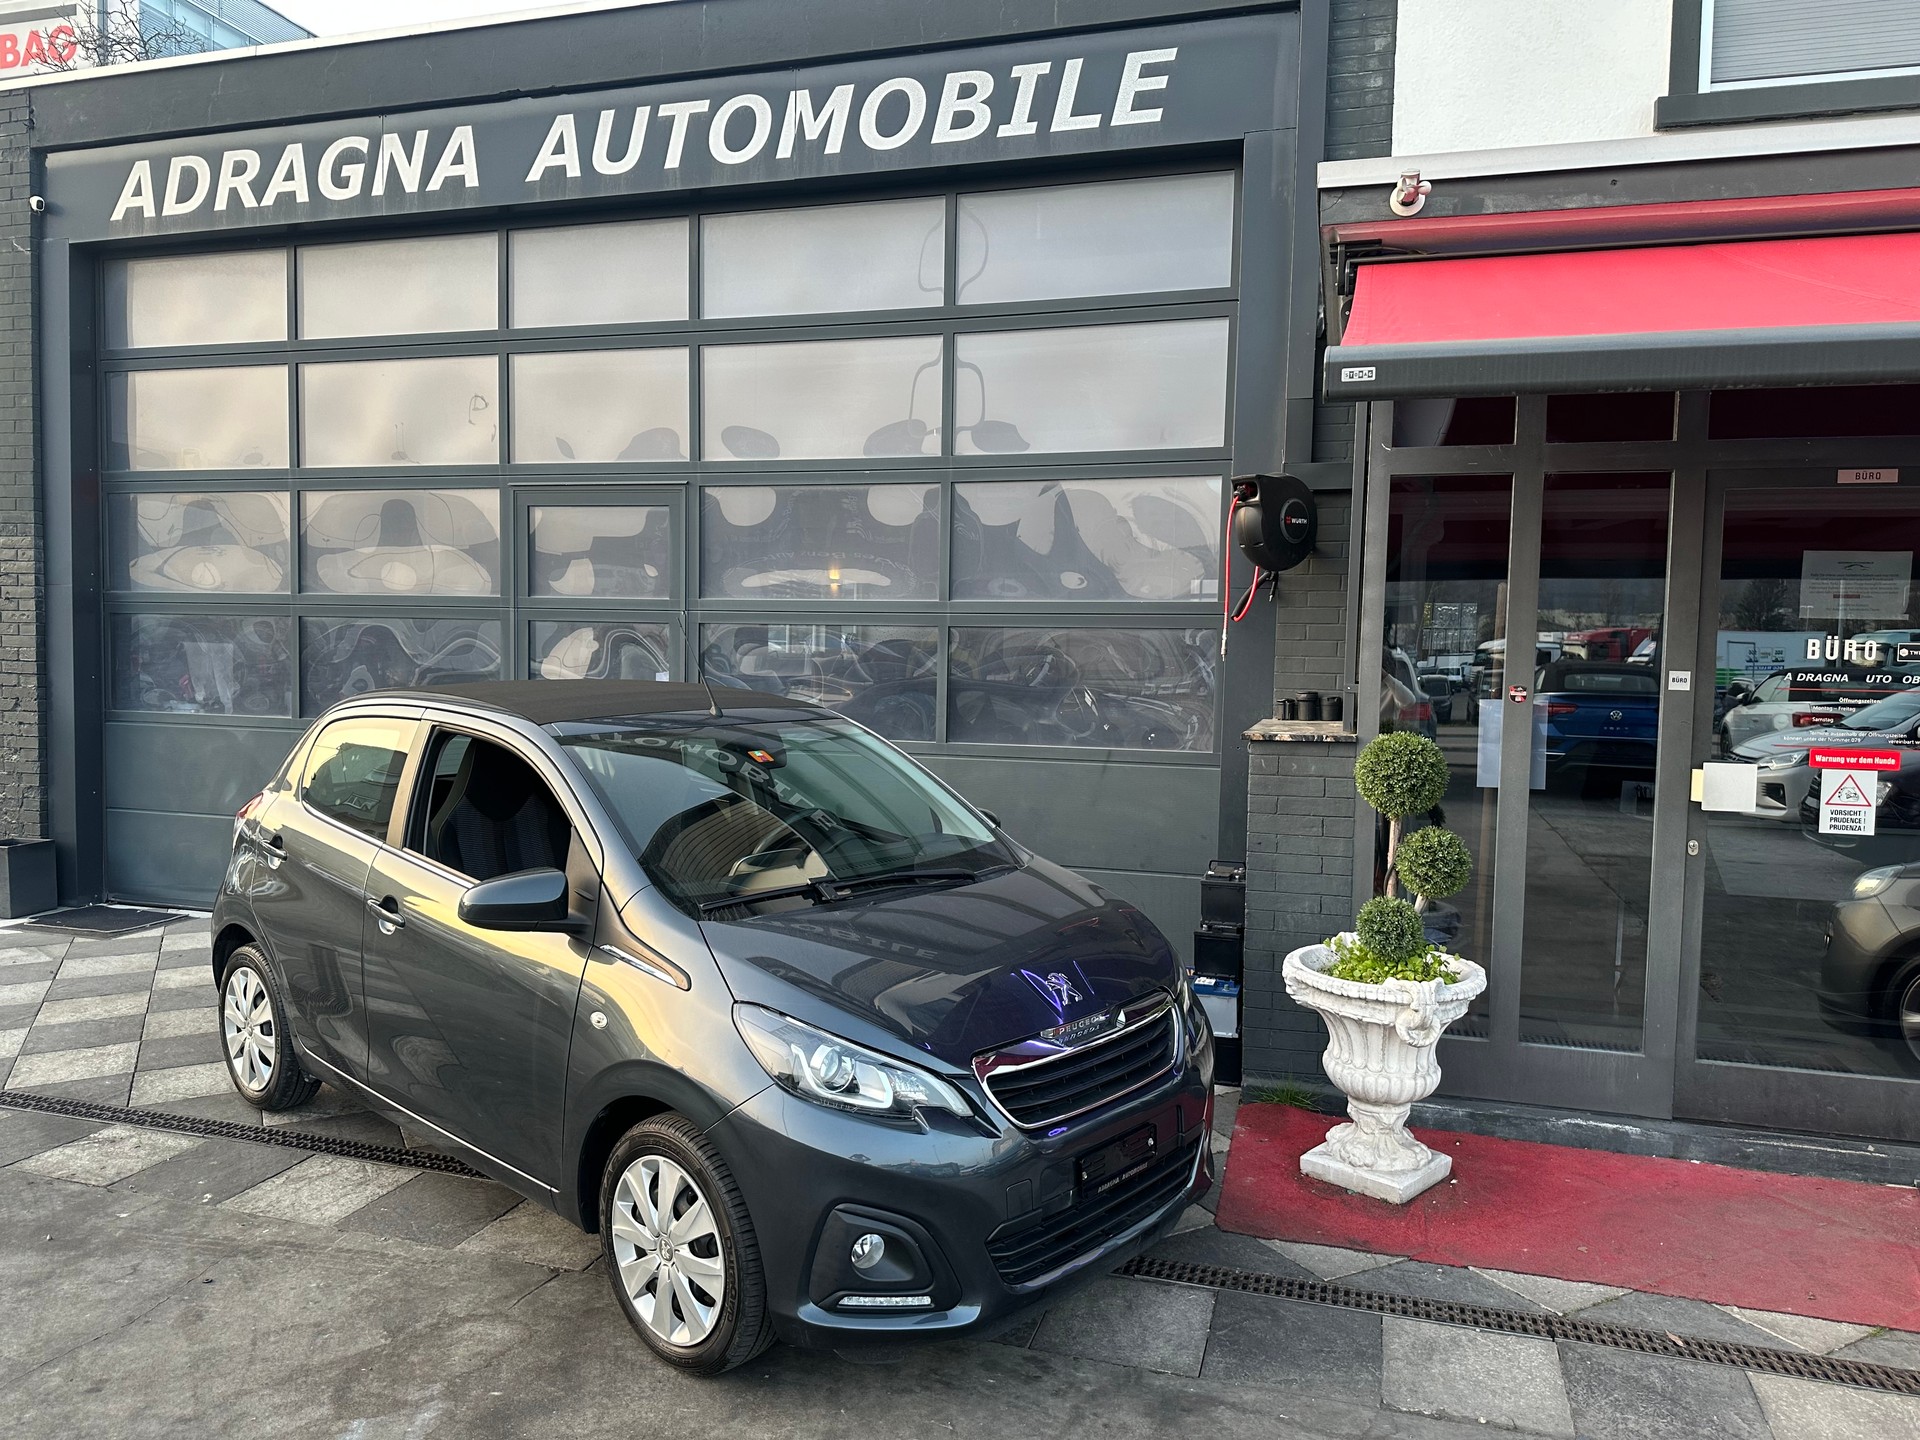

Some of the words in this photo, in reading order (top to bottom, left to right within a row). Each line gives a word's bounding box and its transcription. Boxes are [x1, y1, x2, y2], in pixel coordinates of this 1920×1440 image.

[110, 125, 480, 222] ADRAGNA
[525, 47, 1178, 183] AUTOMOBILE
[1855, 471, 1881, 480] BÜRO
[1806, 635, 1878, 661] BÜRO
[1671, 676, 1688, 684] BÜRO
[1812, 716, 1834, 724] Samstag
[1815, 754, 1845, 764] Warnung
[1846, 756, 1857, 764] vor
[1858, 756, 1873, 764] dem
[1874, 756, 1896, 765] Hunde
[1830, 809, 1862, 817] VORSICHT
[1829, 816, 1862, 825] PRUDENCE
[1829, 824, 1862, 832] PRUDENZA
